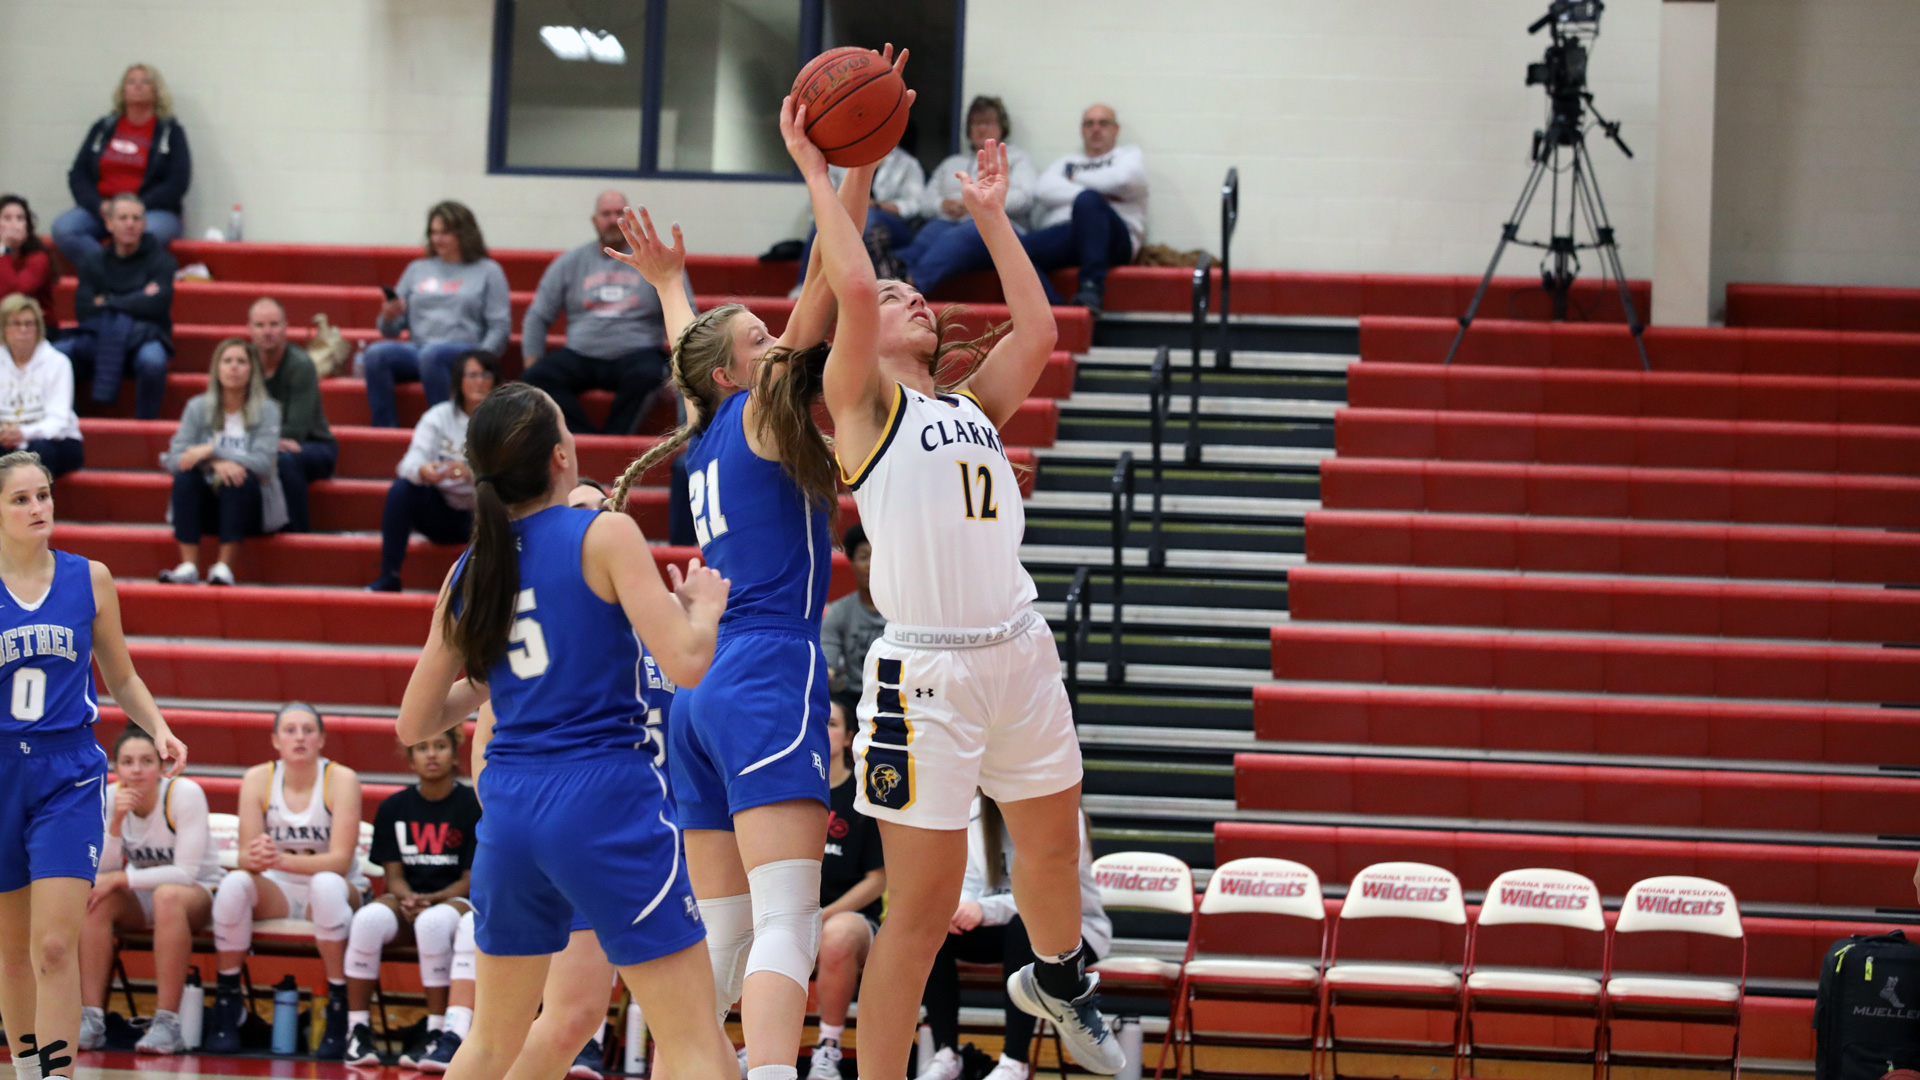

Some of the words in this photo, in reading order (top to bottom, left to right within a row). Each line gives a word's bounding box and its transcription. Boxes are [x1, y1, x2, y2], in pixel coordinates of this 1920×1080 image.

[955, 459, 999, 521] 12
[688, 458, 729, 550] 21
[507, 587, 550, 680] 5
[894, 629, 980, 645] ARMOUR
[10, 666, 47, 722] 0
[1095, 871, 1179, 892] Wildcats
[1220, 878, 1307, 898] Wildcats
[1362, 881, 1450, 903] Wildcats
[1502, 880, 1539, 889] INDIANA
[1637, 887, 1675, 895] INDIANA
[1679, 889, 1727, 898] WESLEYAN
[1500, 887, 1589, 911] Wildcats
[1637, 894, 1726, 917] Wildcats
